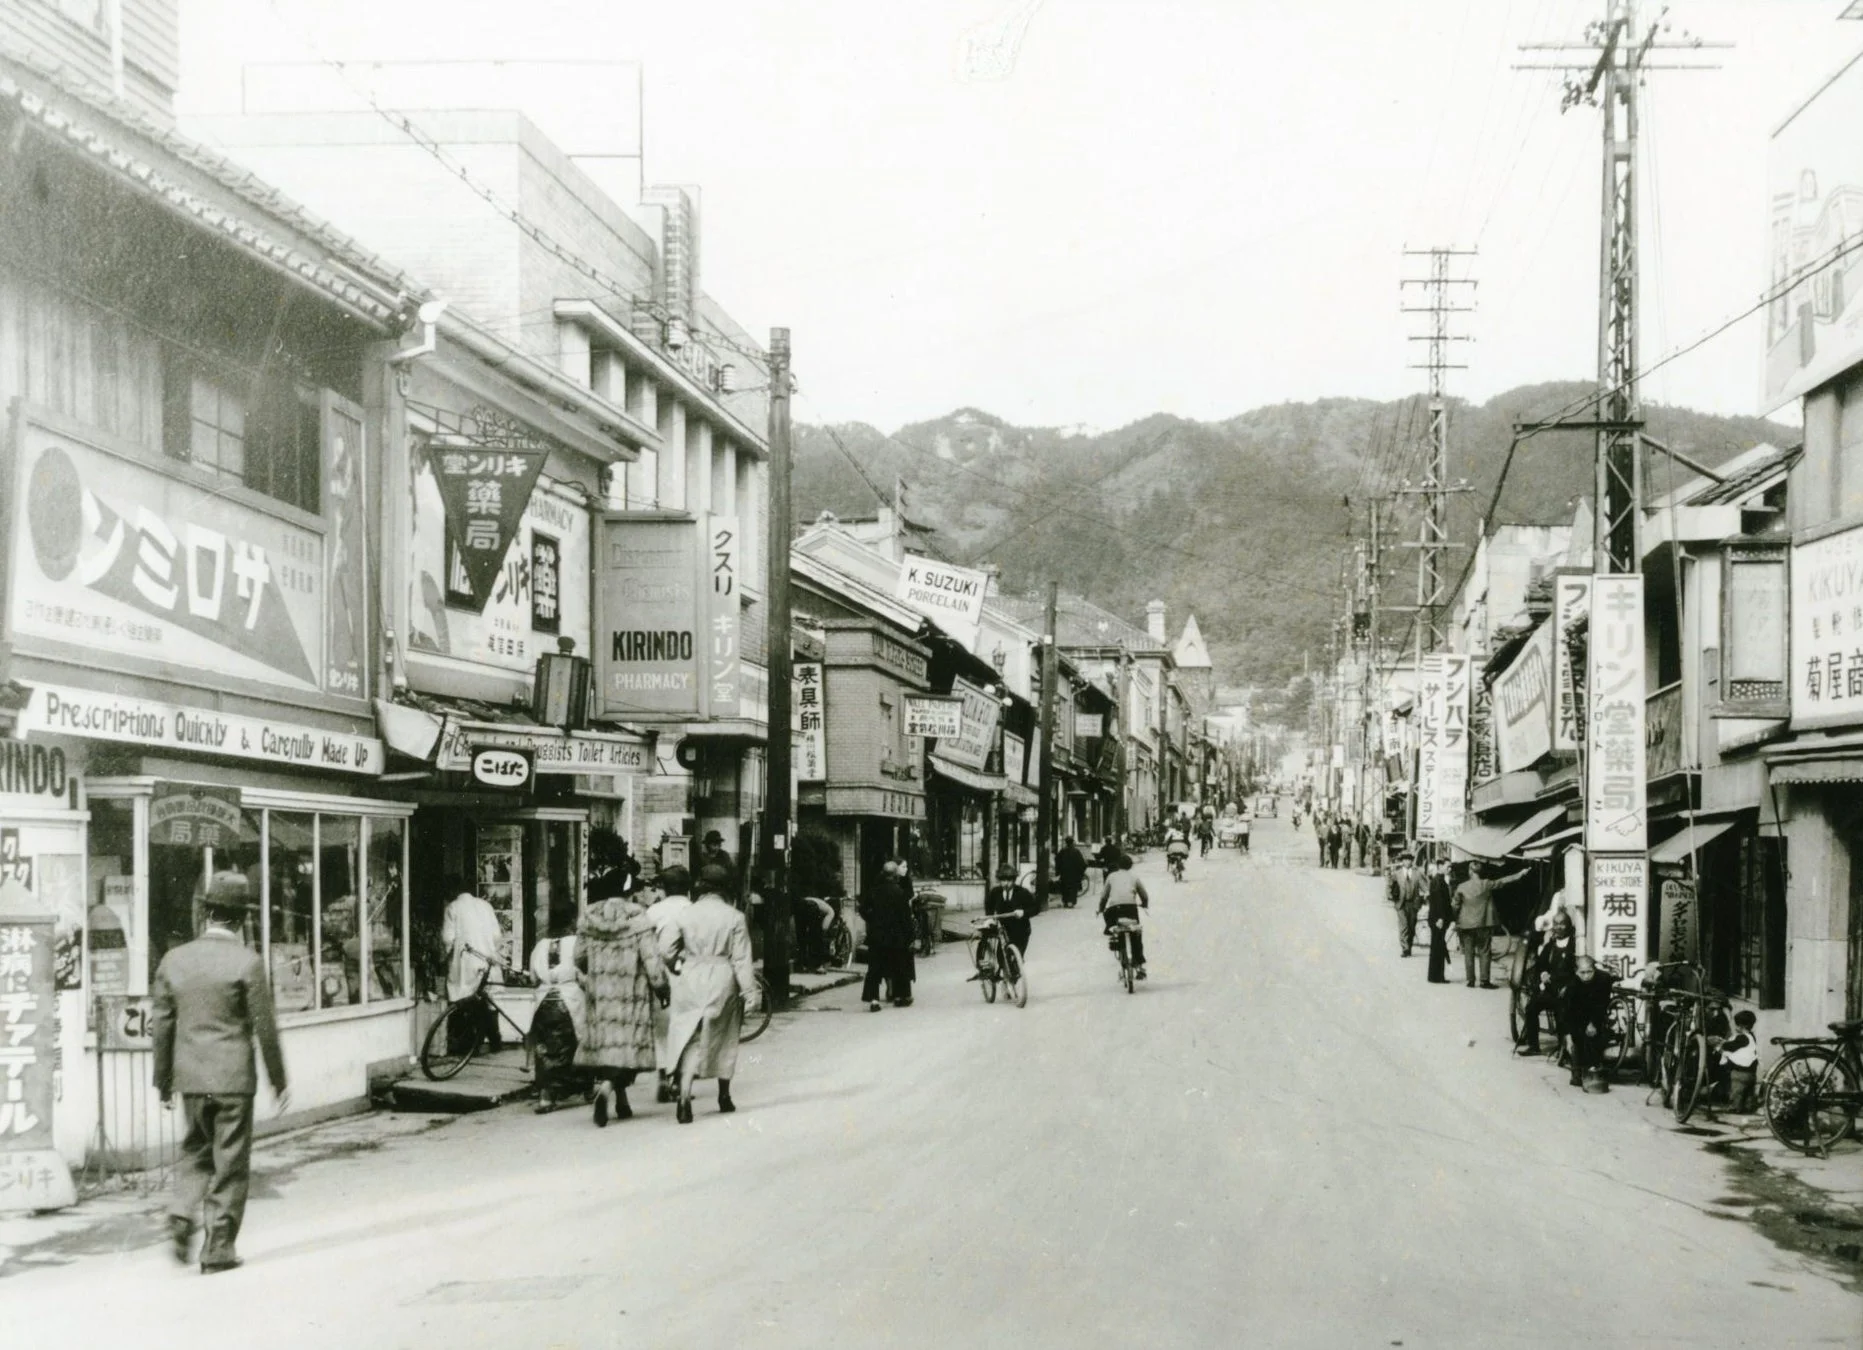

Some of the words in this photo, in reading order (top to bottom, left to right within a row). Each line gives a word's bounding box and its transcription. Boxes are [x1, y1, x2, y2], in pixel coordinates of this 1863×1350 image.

[530, 496, 574, 533] HARMACY
[714, 530, 733, 596] クスリ
[908, 568, 922, 584] K.
[925, 572, 978, 598] SUZUKI
[908, 588, 970, 613] PORCELAIN
[612, 631, 693, 661] KIRINDO
[713, 614, 734, 703] キリン堂
[615, 673, 689, 691] PHARMACY
[799, 665, 821, 731] 表具師
[46, 691, 165, 739] Prescriptions
[175, 711, 228, 748] Quickly
[241, 727, 251, 751] &
[261, 727, 315, 760] Carefully
[321, 736, 348, 765] Made
[0, 741, 66, 797] INDO
[578, 741, 604, 763] Toilet
[610, 745, 641, 767] Articles
[1597, 861, 1642, 874] KIKUYA
